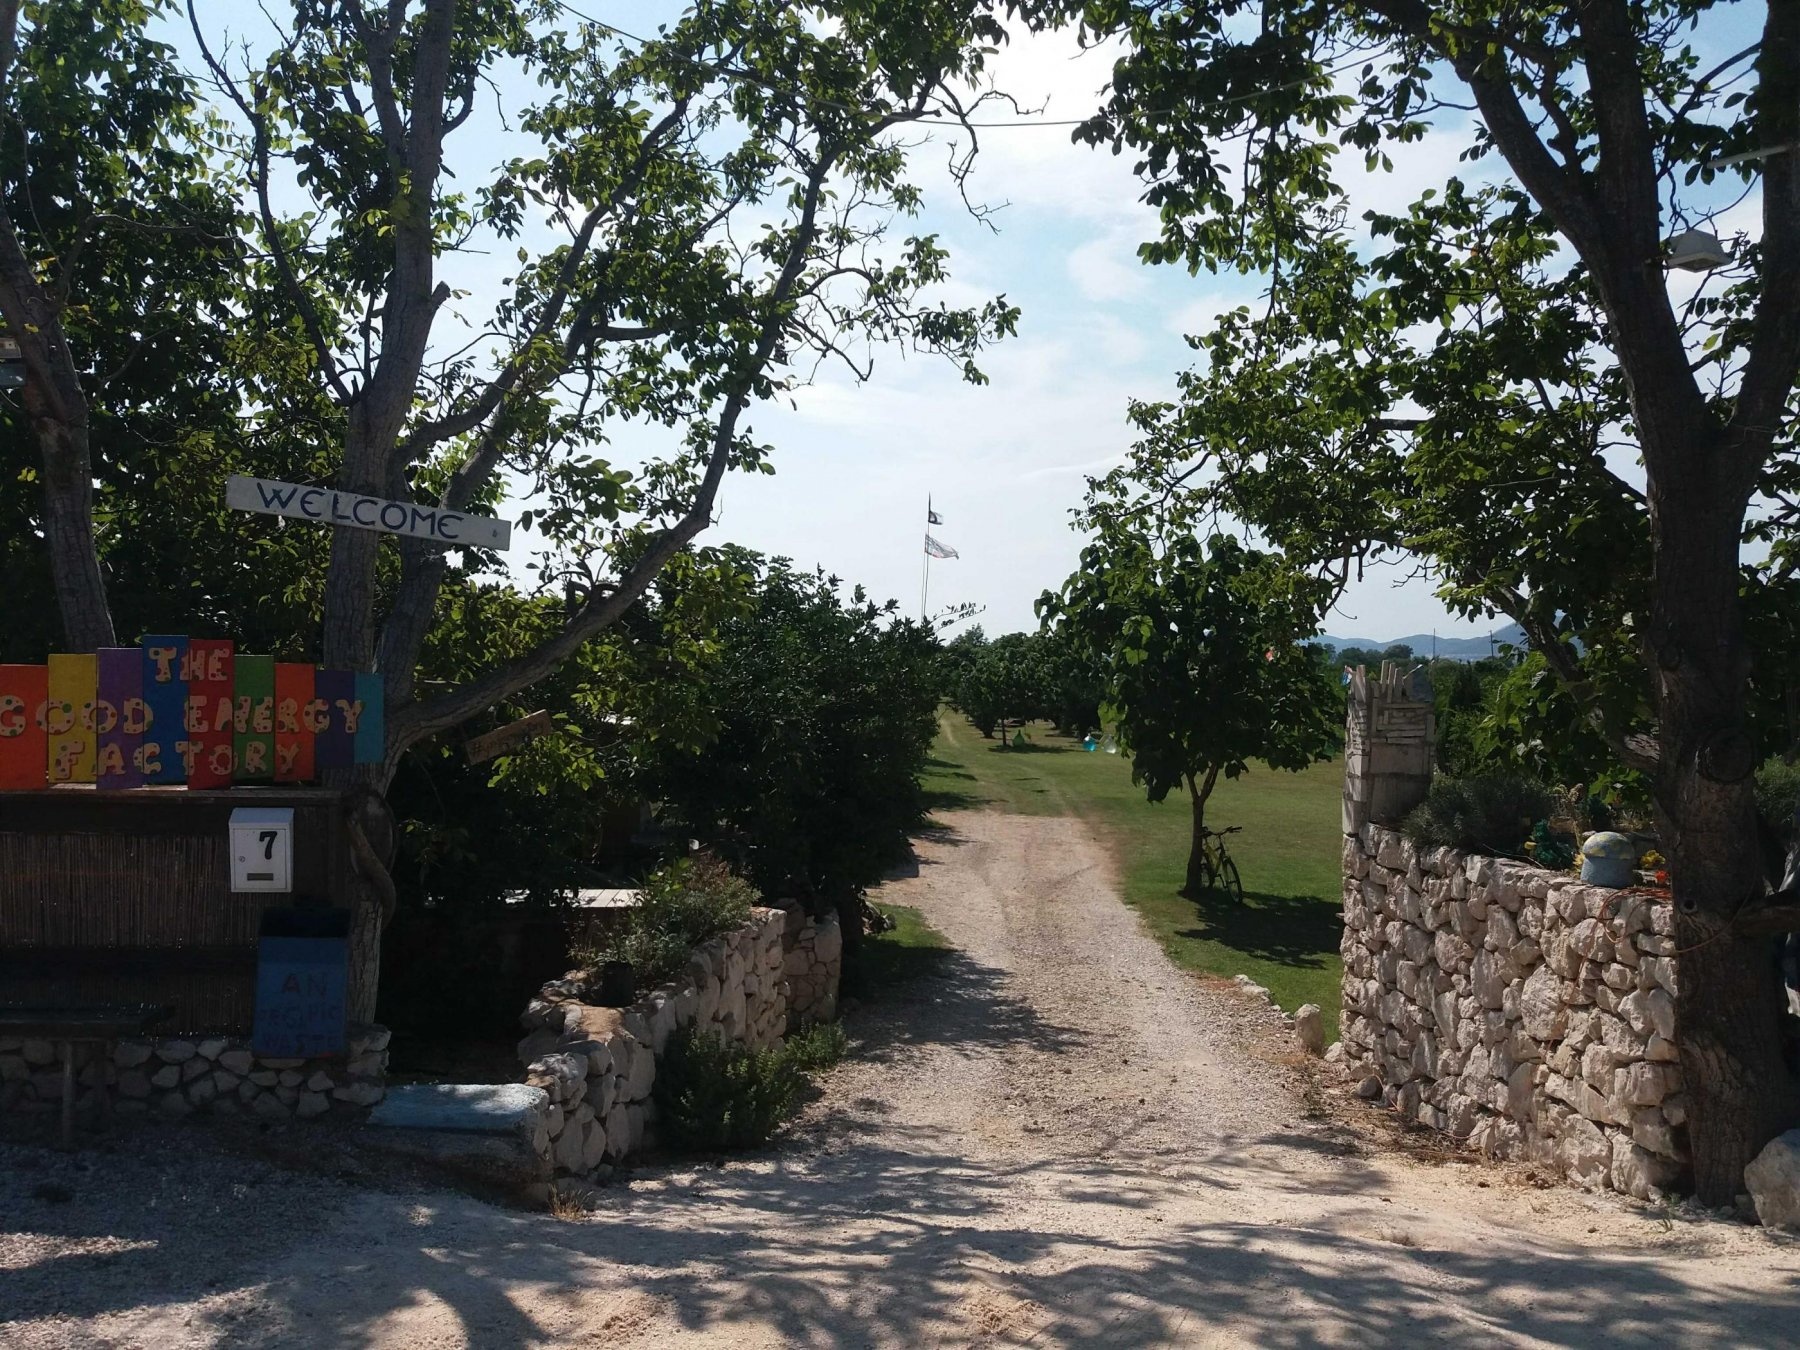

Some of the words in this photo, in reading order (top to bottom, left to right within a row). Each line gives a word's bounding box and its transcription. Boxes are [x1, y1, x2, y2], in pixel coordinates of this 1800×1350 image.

[257, 482, 465, 539] WELCOME
[149, 646, 231, 682] THE
[0, 695, 154, 737] GOOD
[184, 695, 365, 734] ENERGY
[54, 740, 300, 780] FACTORY
[258, 831, 278, 860] 7
